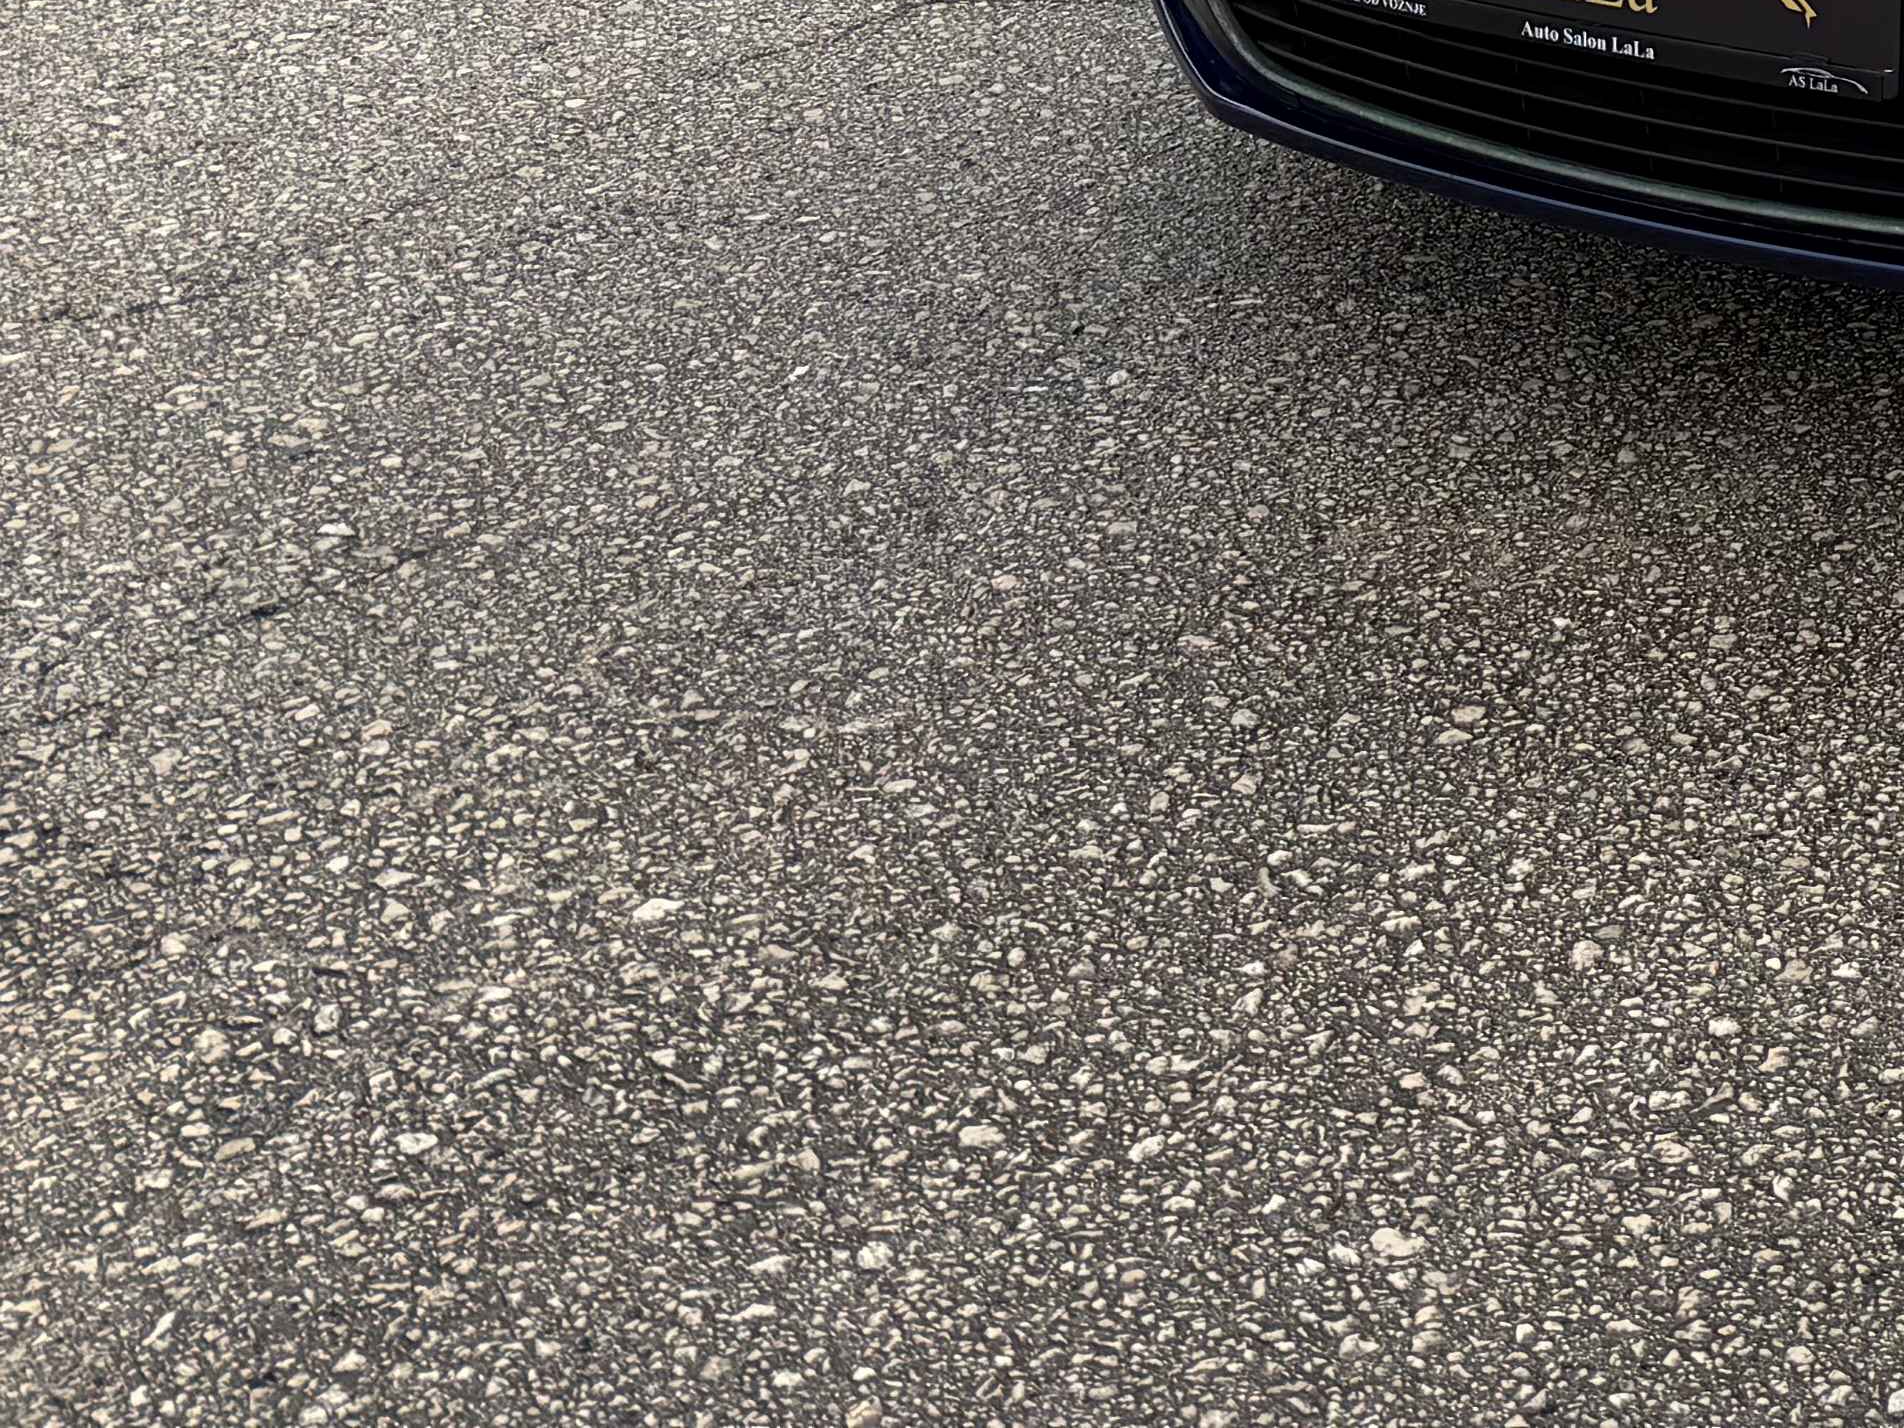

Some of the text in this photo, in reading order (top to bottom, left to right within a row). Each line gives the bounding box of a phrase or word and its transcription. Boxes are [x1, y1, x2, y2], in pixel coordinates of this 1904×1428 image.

[1521, 21, 1655, 60] Auto Salon LaLa
[1788, 74, 1838, 92] AS LaLa
